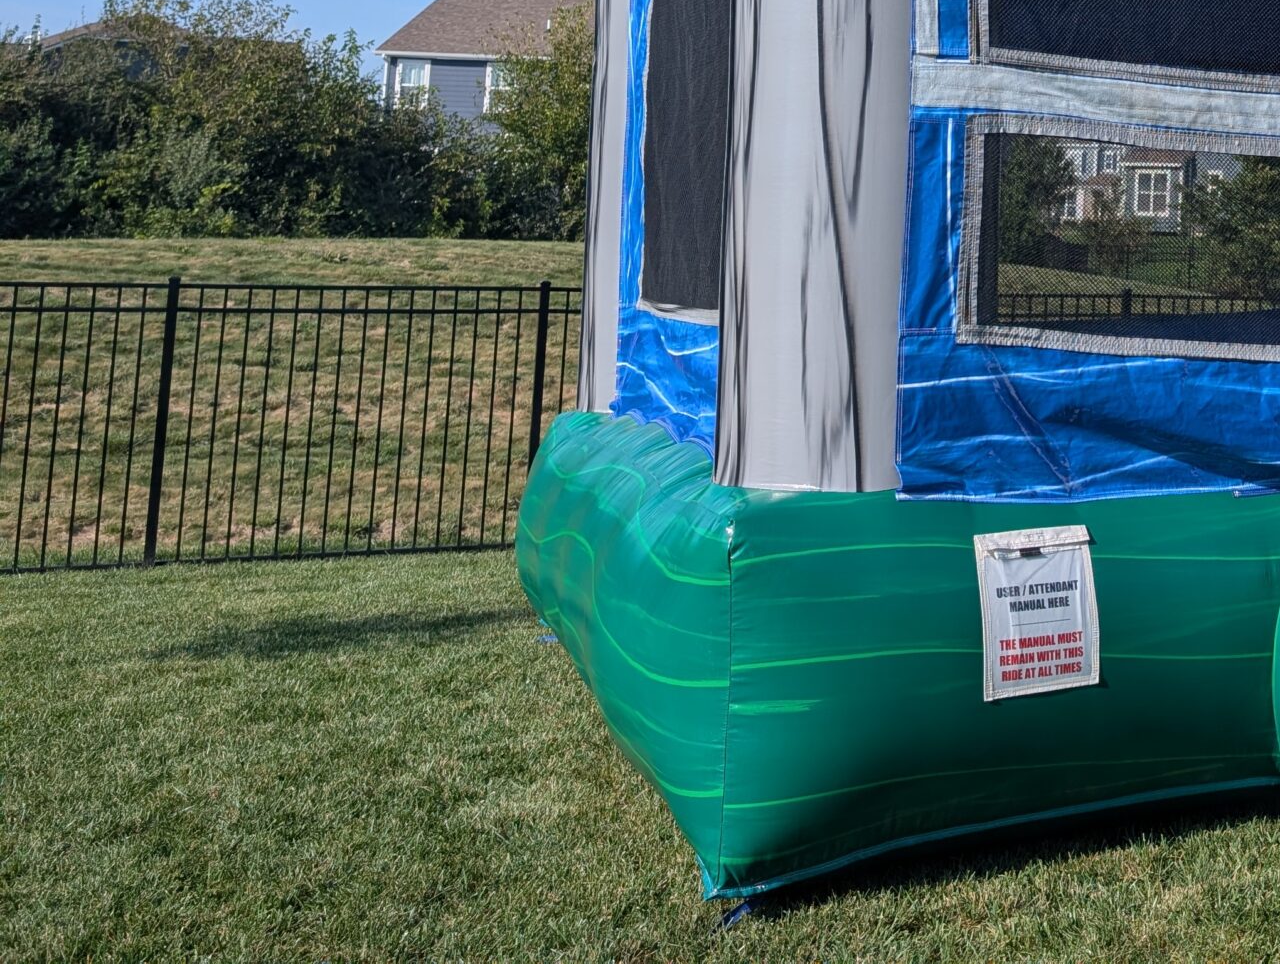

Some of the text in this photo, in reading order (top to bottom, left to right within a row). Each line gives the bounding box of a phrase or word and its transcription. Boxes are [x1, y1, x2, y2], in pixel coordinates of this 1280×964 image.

[996, 580, 1078, 599] USER / ATTENDANT
[1009, 596, 1070, 612] MANUAL HERE
[1000, 631, 1082, 651] THE MANUAL MUST
[999, 647, 1083, 666] REMAIN WITH THIS
[1002, 663, 1081, 681] RIDE AT ALL TIMES
